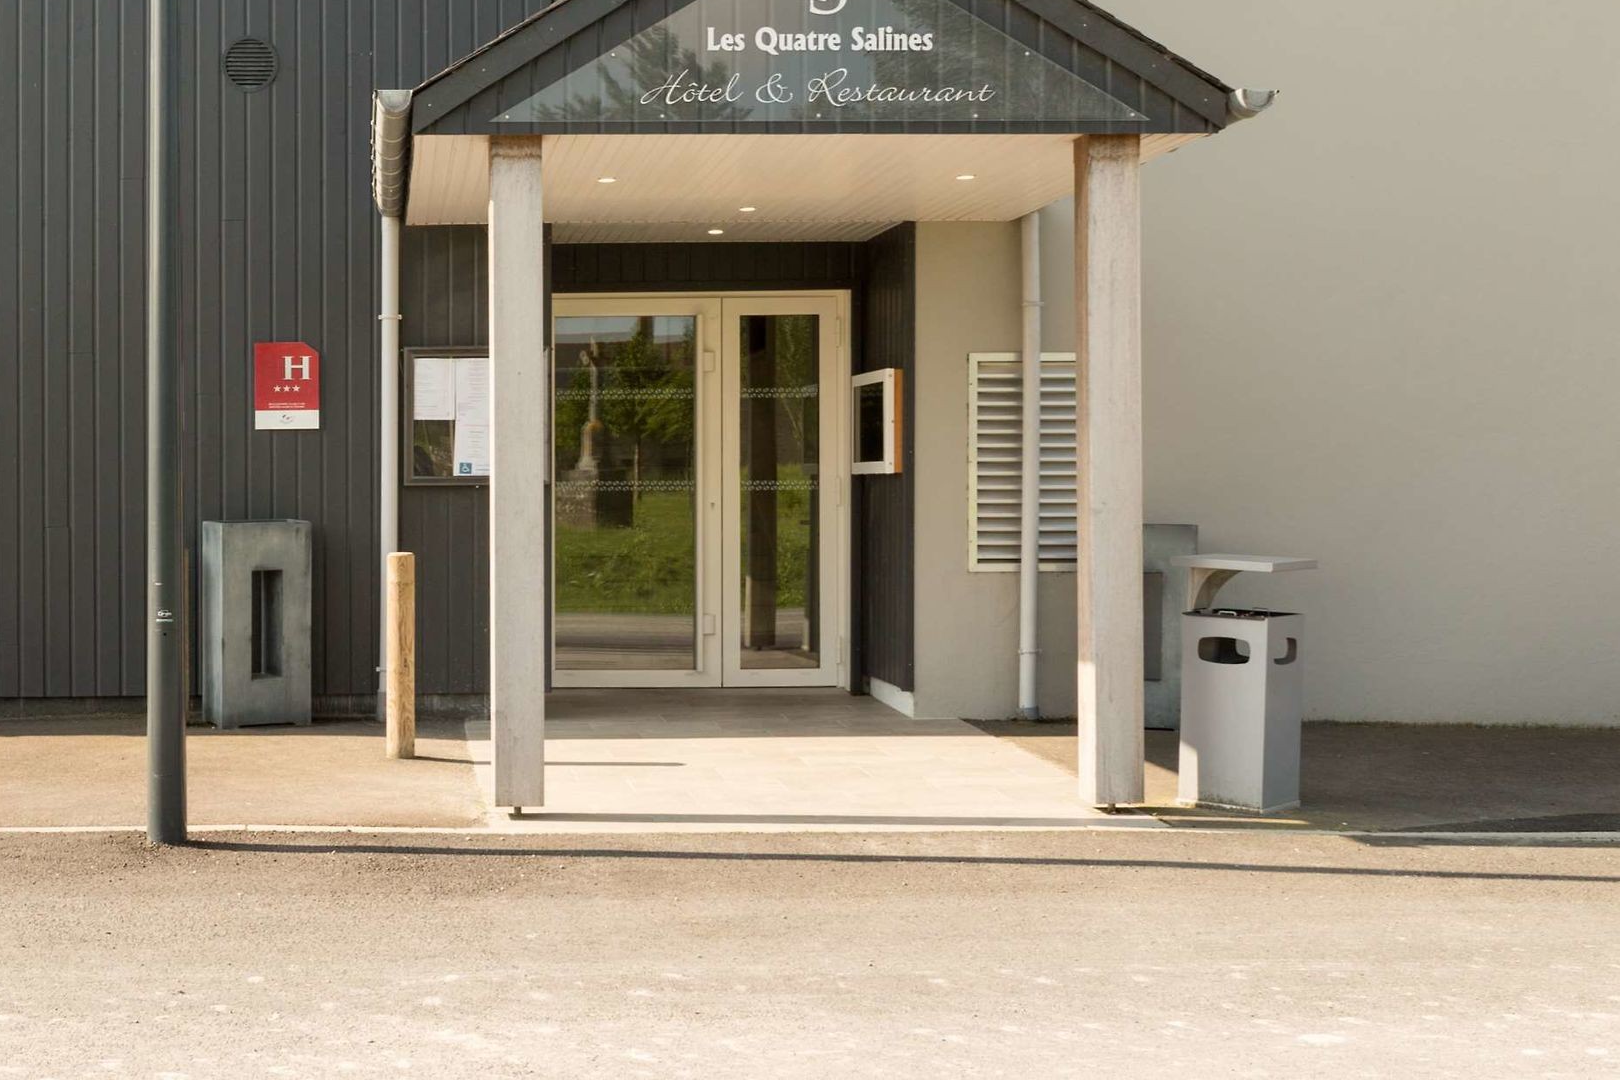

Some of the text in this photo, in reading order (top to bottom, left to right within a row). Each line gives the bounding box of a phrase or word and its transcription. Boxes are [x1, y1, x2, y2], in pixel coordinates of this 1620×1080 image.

[707, 26, 933, 55] Les Quatre Salines
[640, 68, 996, 107] Hôtel & Restaurant
[282, 356, 313, 380] H
